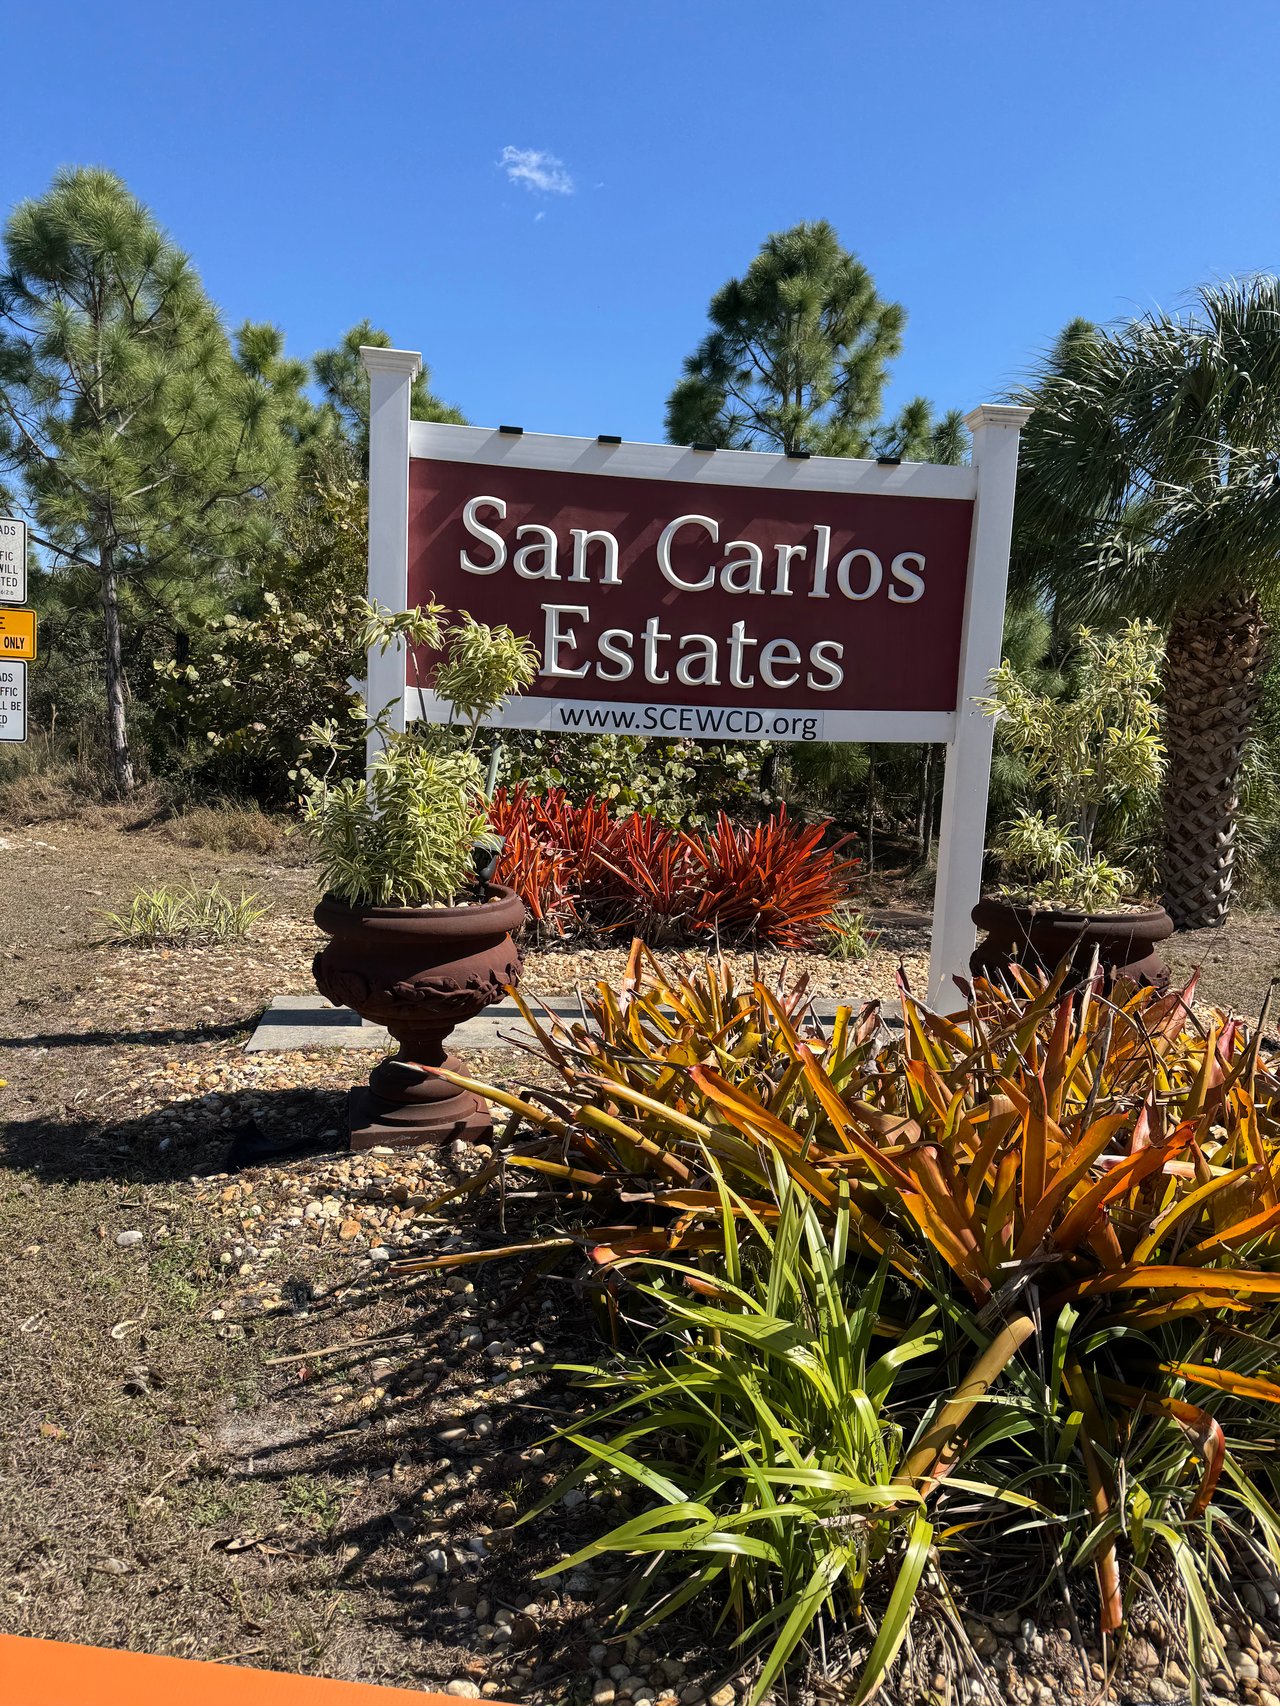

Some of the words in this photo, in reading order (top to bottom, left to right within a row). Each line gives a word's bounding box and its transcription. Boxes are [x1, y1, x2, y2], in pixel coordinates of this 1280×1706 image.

[459, 495, 622, 585] San
[656, 514, 926, 604] Carlos
[4, 636, 25, 650] ONLY
[539, 603, 844, 692] Estates
[10, 701, 22, 711] BE
[560, 707, 817, 740] www.SCEWCD.org
